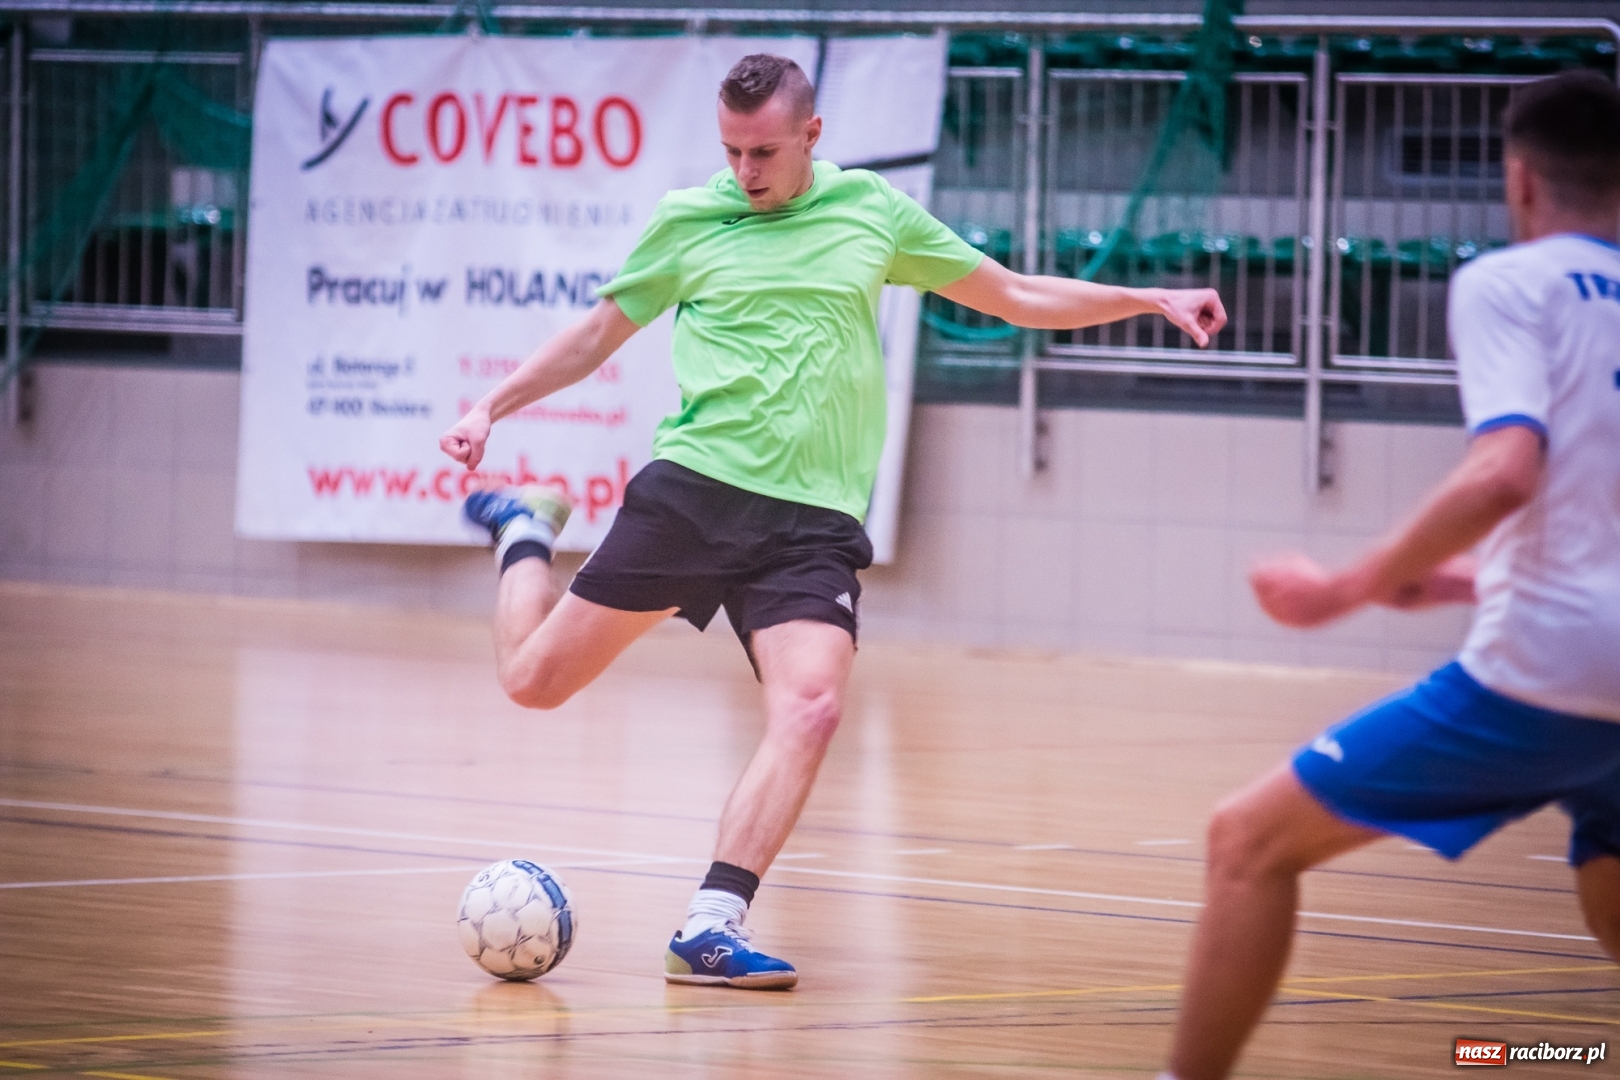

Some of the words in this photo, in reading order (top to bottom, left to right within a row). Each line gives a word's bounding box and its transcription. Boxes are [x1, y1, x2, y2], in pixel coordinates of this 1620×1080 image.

[379, 91, 643, 169] COVEBO
[306, 265, 408, 317] Pracuj
[415, 278, 448, 300] w
[466, 267, 613, 310] HOLAND
